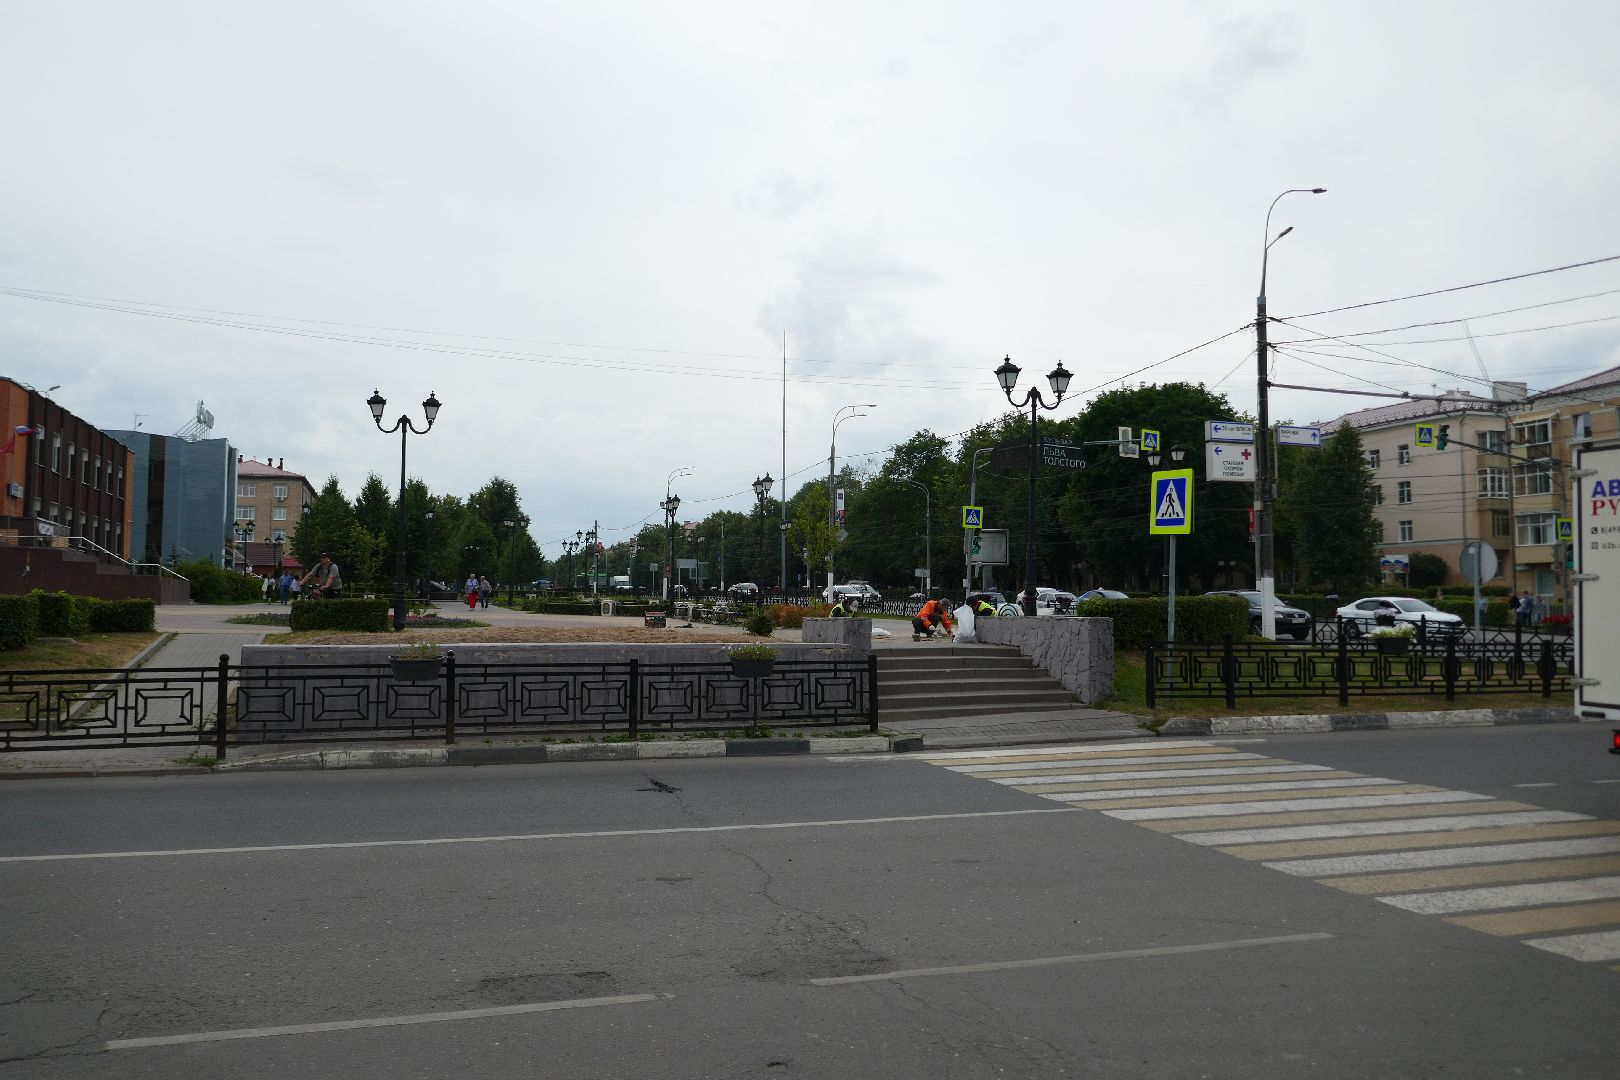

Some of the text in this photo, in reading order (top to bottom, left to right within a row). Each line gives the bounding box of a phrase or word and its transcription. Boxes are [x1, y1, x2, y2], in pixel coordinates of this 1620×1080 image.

[1044, 437, 1073, 445] БУЛЬВАР
[1043, 446, 1066, 457] ЛЬВА
[1044, 457, 1085, 468] ТОЛСТОГО
